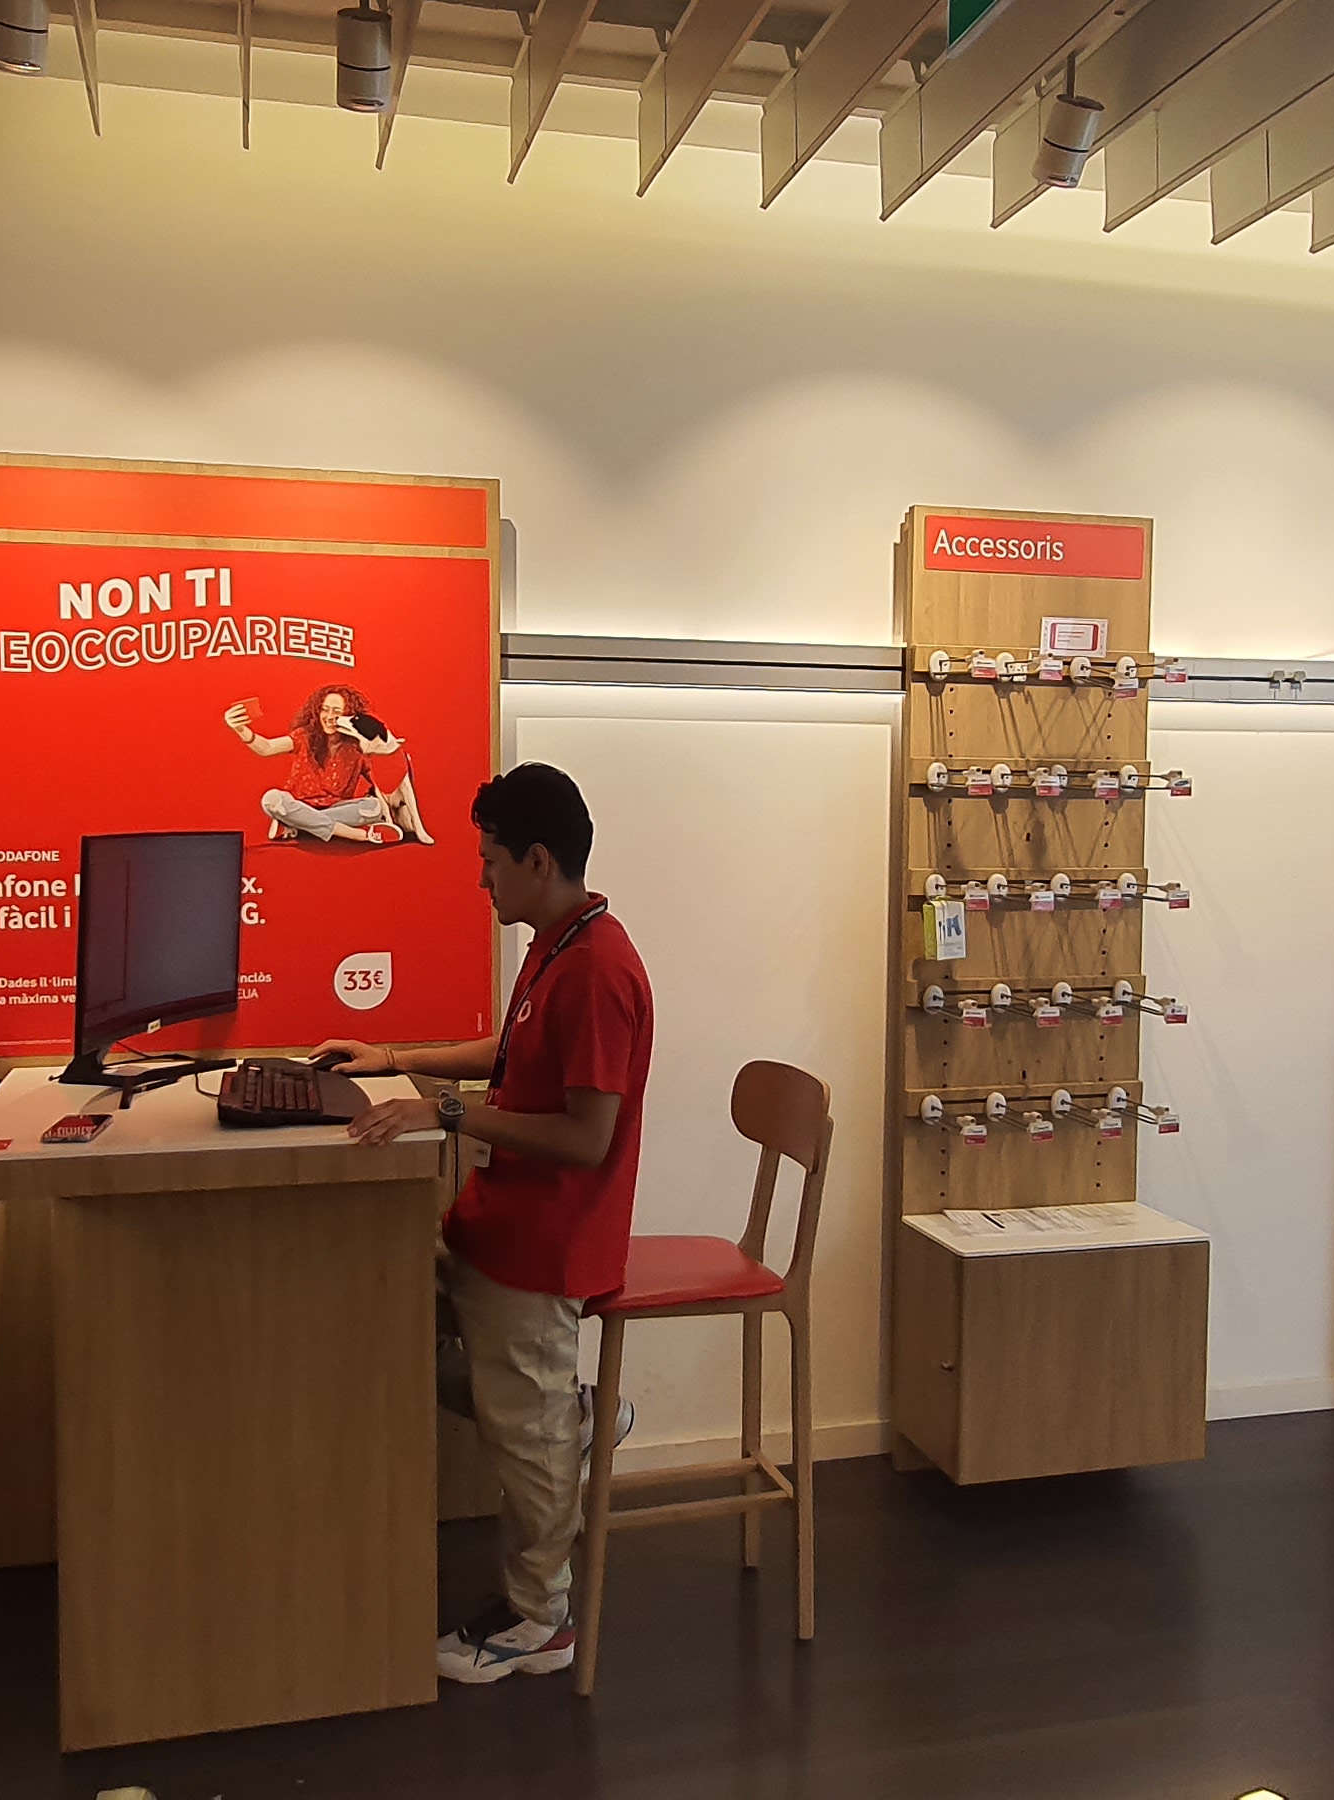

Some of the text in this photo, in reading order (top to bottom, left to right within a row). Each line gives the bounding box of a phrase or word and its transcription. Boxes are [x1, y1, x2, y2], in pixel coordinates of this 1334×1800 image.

[932, 528, 1064, 561] Accessoris
[59, 567, 231, 620] NON TI
[241, 877, 263, 894] x.
[64, 905, 71, 928] i
[240, 902, 266, 924] G.
[343, 970, 384, 991] 33€
[8, 993, 59, 1004] màxima
